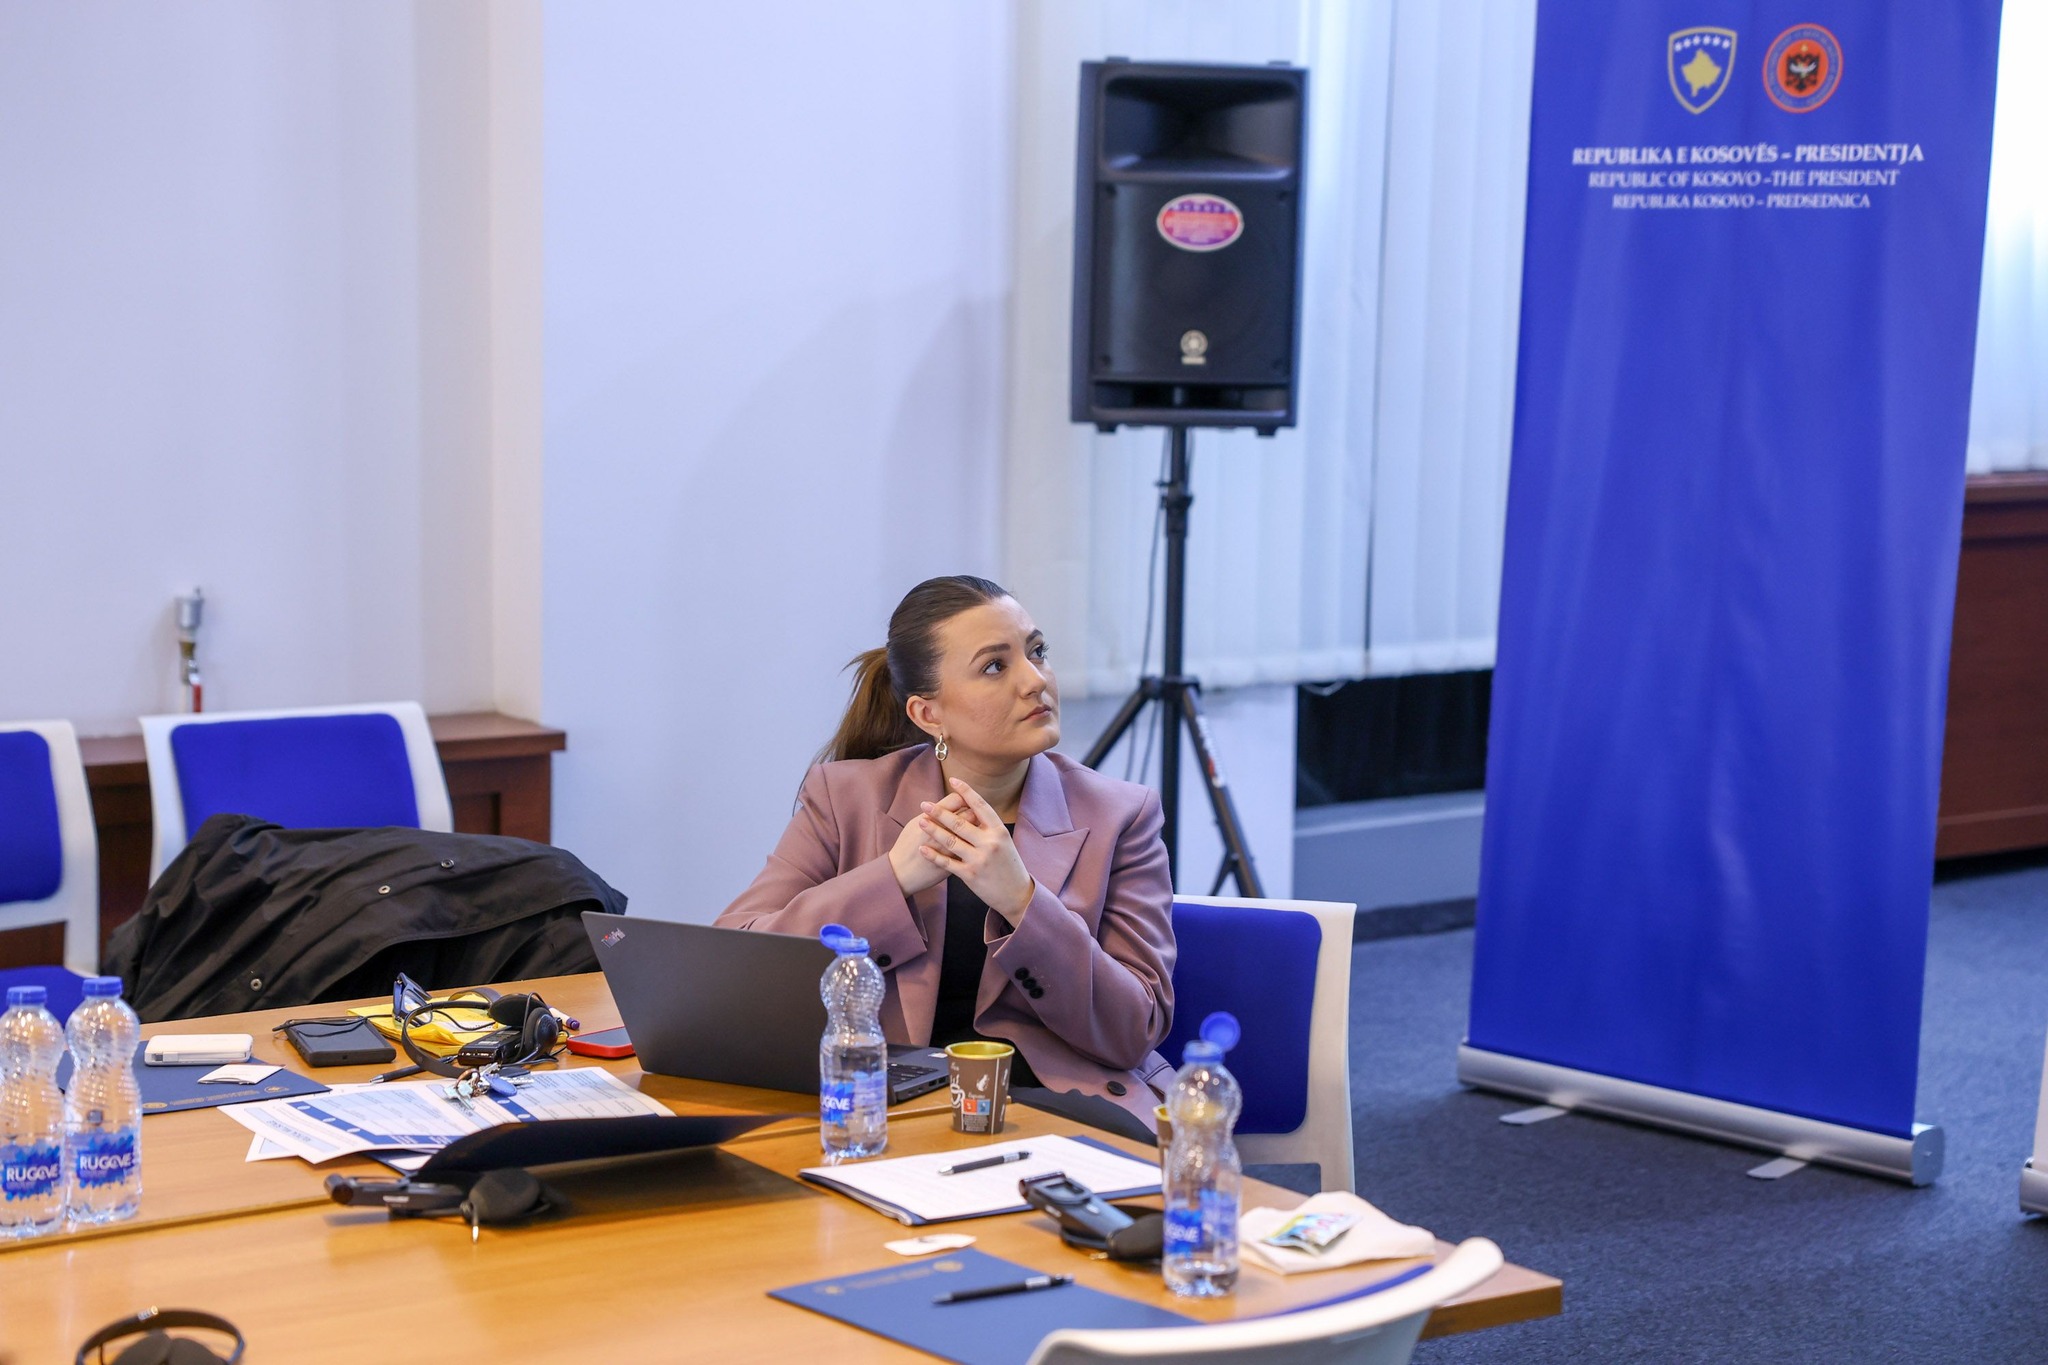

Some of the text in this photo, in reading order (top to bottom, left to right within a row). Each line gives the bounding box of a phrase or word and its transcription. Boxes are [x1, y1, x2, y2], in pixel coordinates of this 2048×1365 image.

[1572, 147, 1673, 165] REPUBLIKA
[1676, 146, 1688, 164] E
[1690, 141, 1779, 164] KOSOVËS
[1794, 143, 1925, 165] PRESIDENTJA
[1588, 170, 1666, 188] REPUBLIC
[1667, 170, 1690, 187] OF
[1692, 169, 1762, 187] KOSOVO
[1807, 168, 1899, 187] PRESIDENT
[1612, 193, 1690, 209] REPUBLIKA
[1692, 192, 1755, 209] KOSOVO
[1766, 192, 1871, 208] PREDSEDNICA
[79, 1152, 132, 1171] RUGOVE
[6, 1163, 59, 1182] RUGOVE
